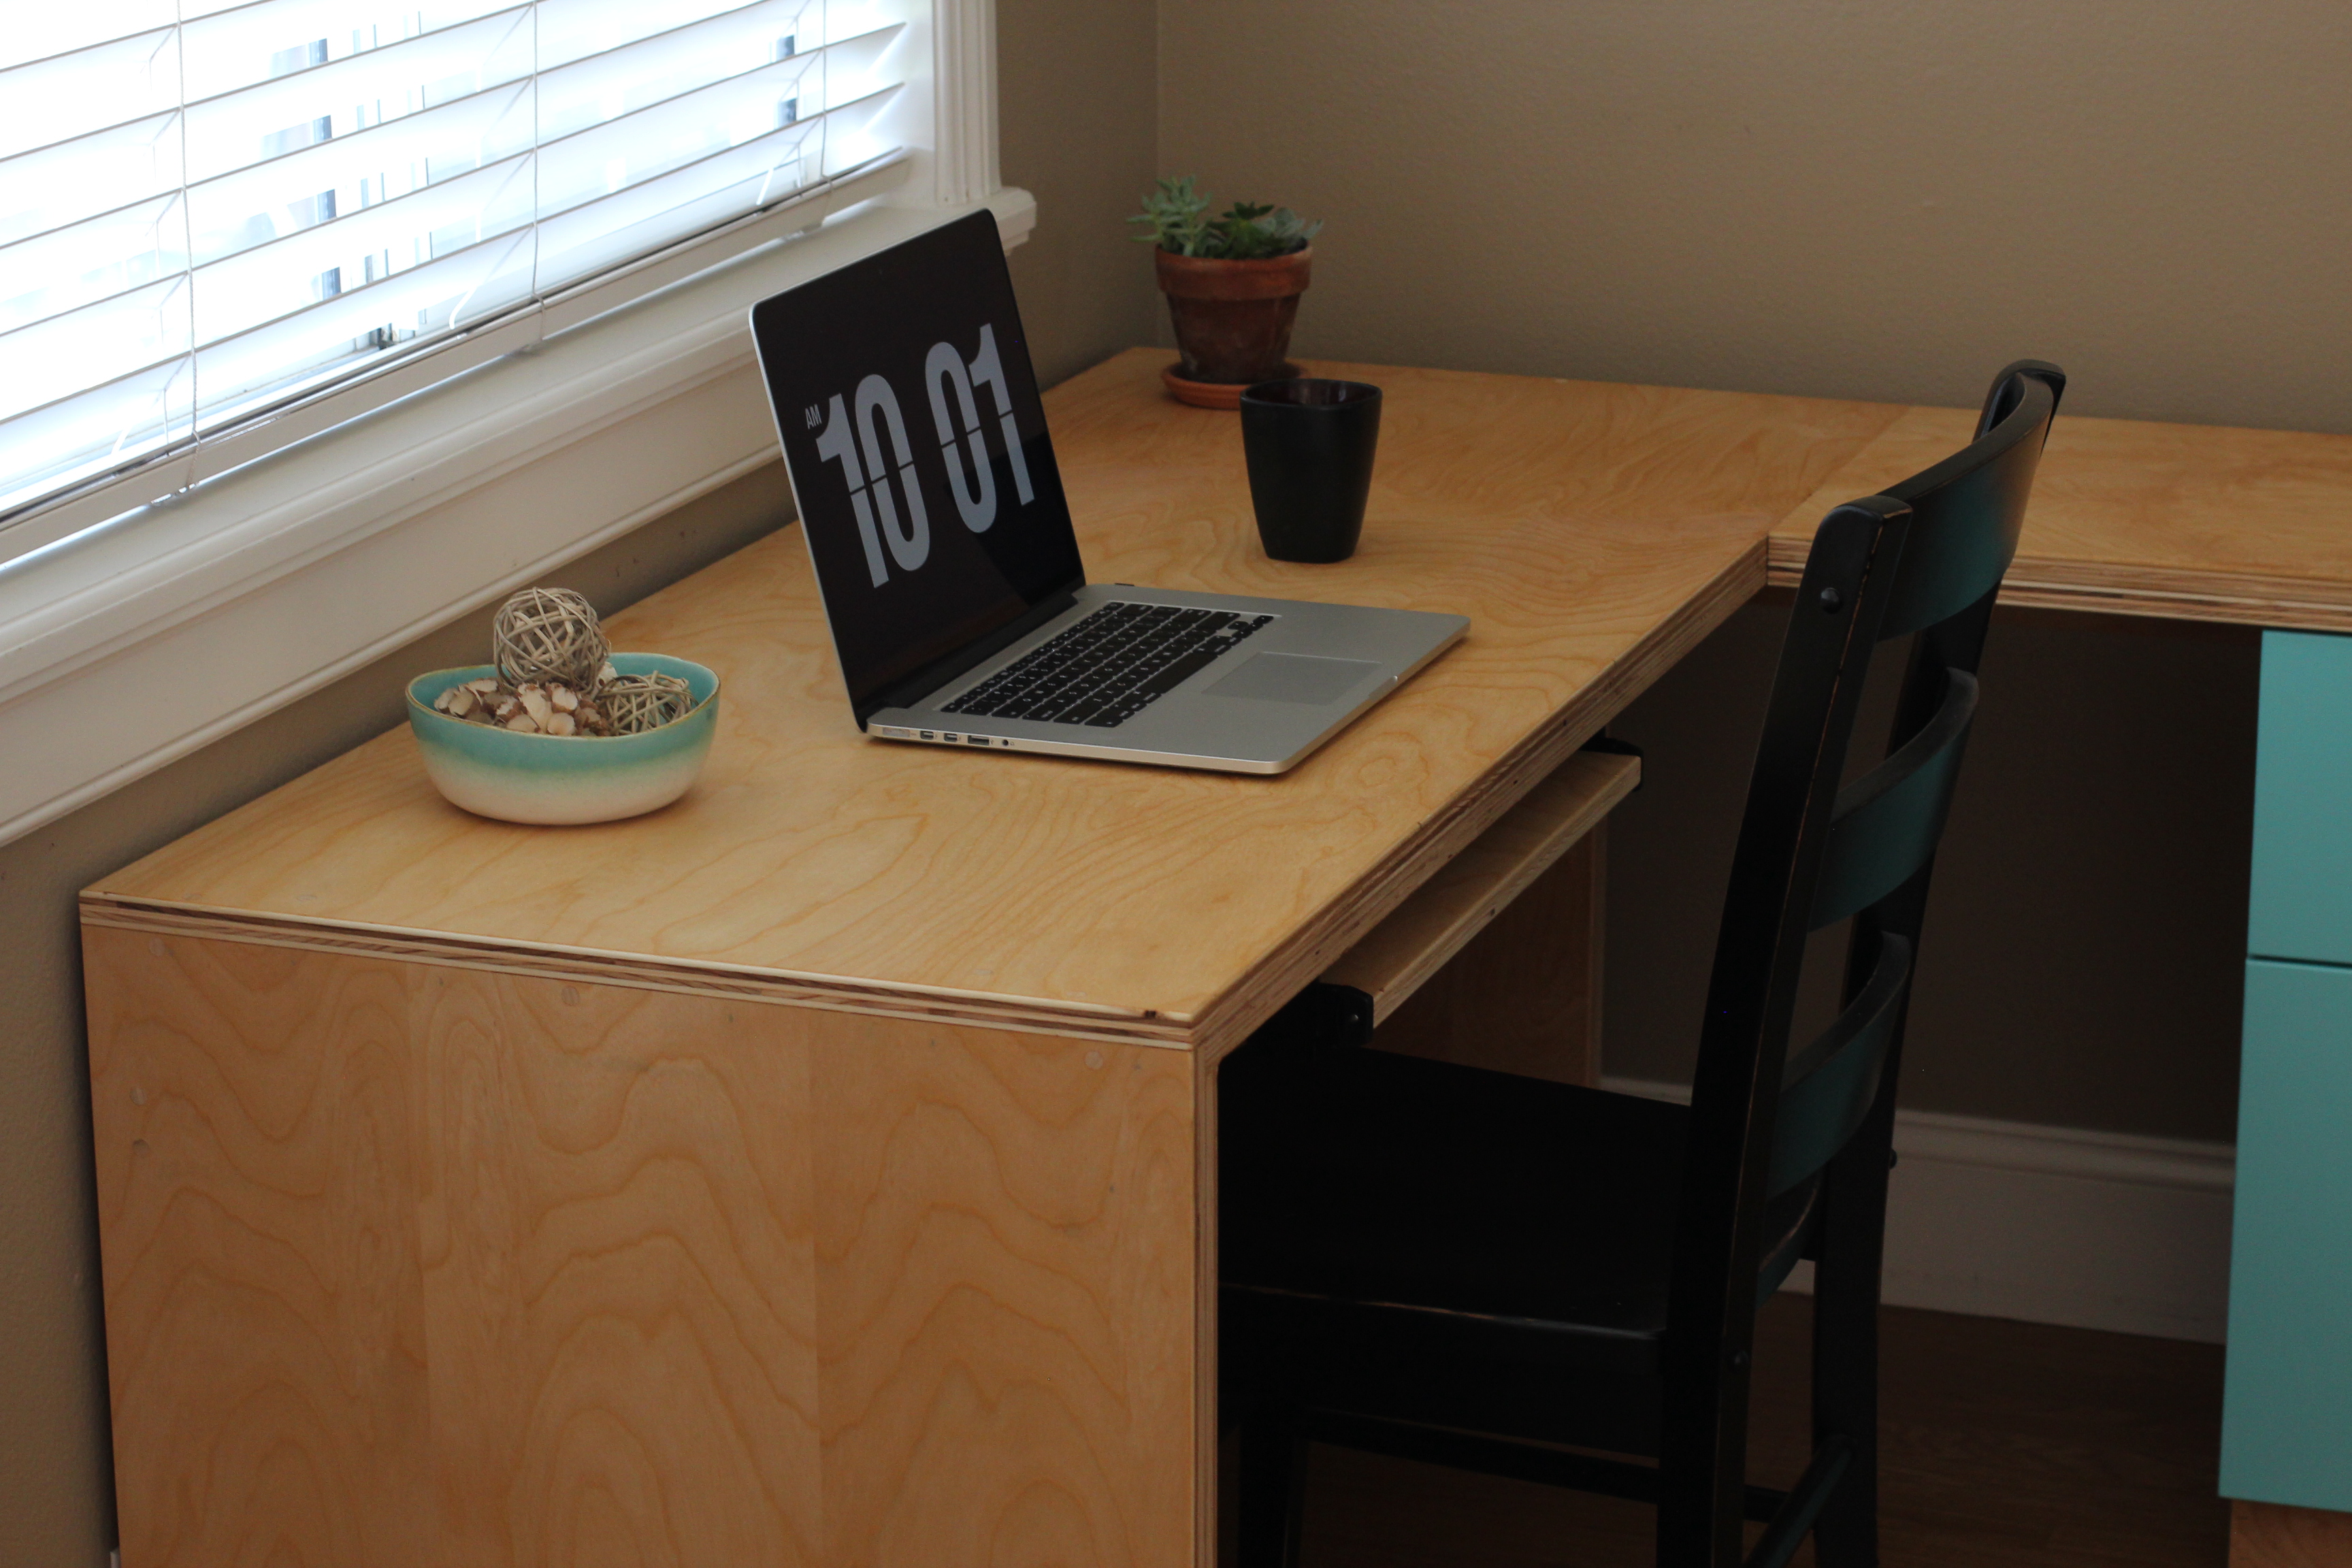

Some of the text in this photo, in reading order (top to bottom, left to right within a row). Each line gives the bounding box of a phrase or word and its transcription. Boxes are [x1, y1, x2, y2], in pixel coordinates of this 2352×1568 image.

[804, 323, 1034, 588] AM 10 01
